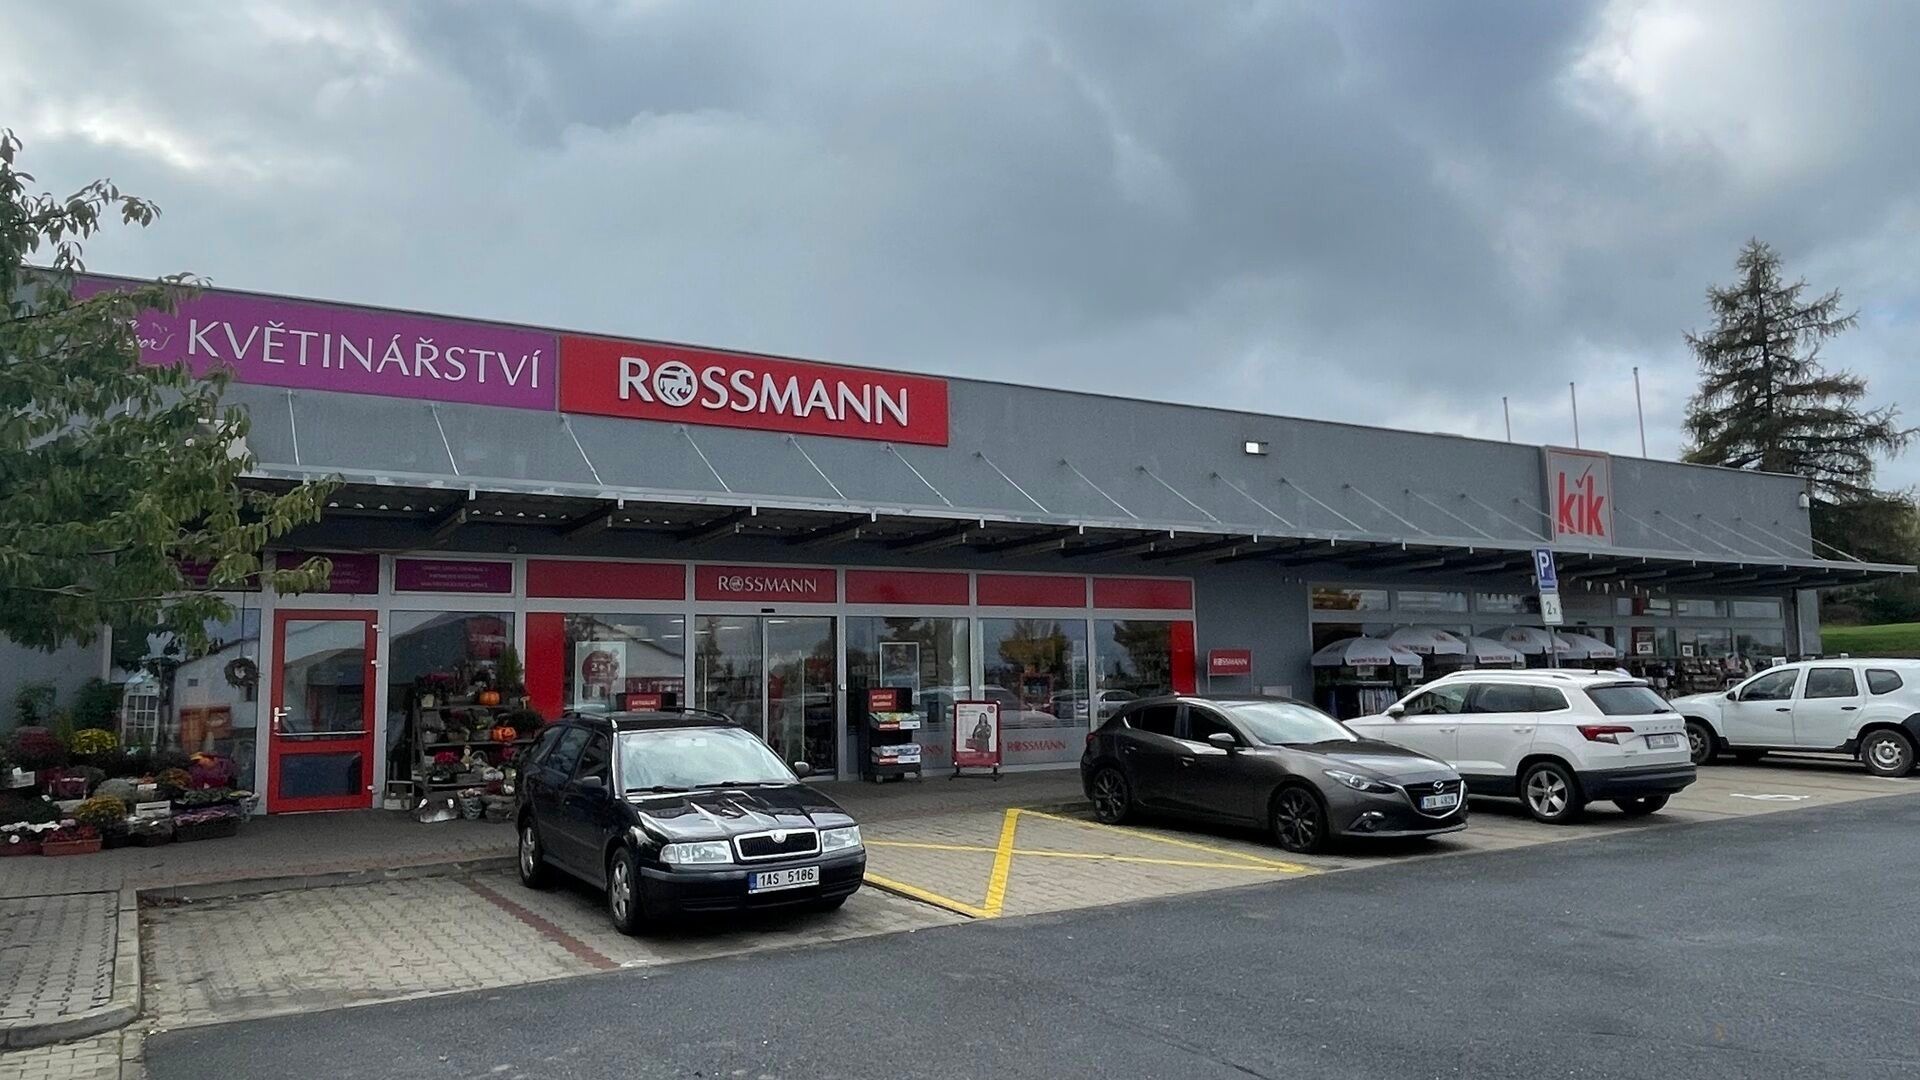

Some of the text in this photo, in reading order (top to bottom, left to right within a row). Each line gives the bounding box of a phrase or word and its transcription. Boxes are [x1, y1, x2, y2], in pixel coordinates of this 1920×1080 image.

[187, 318, 542, 389] KVĚTINÁŘSTVÍ
[618, 356, 909, 427] ROSSMANN
[1558, 463, 1605, 537] kik
[1538, 551, 1550, 578] P
[718, 575, 817, 593] ROSSMANN
[1213, 657, 1248, 666] ROSSMANN
[1007, 739, 1067, 753] ROSSMANN
[760, 868, 814, 887] 1AS 5186
